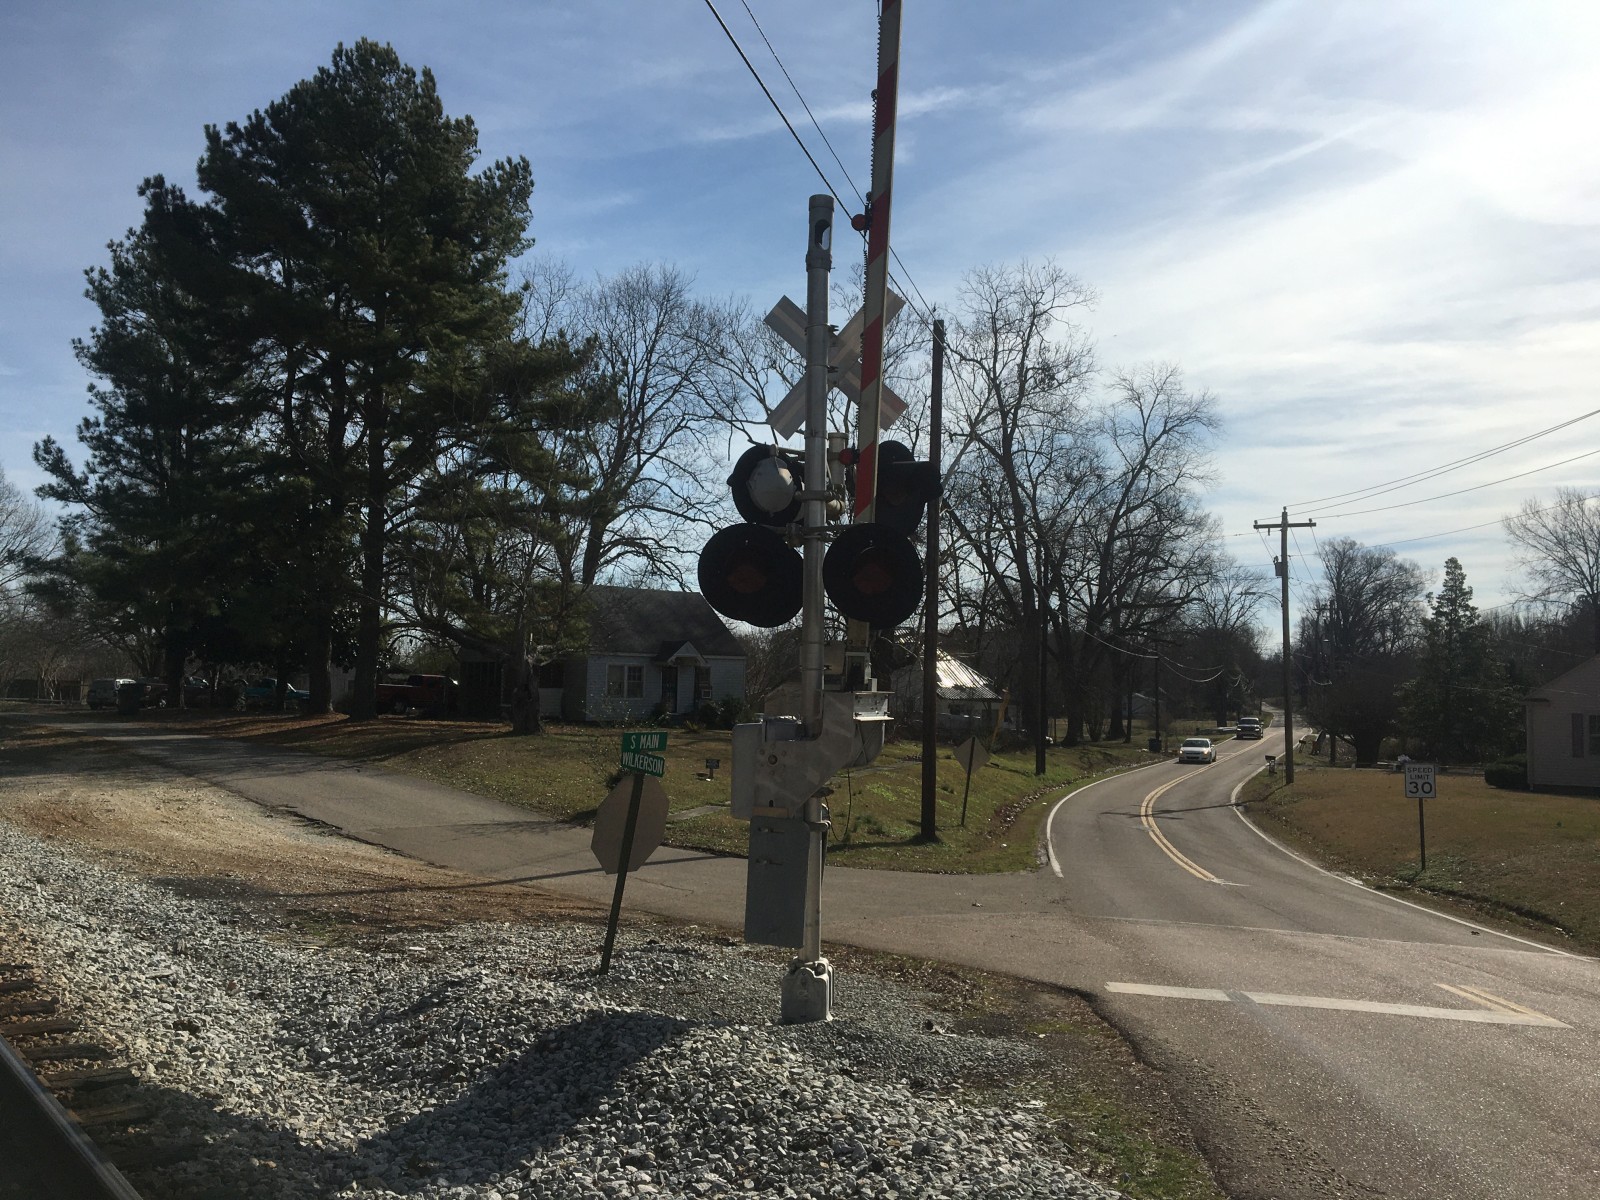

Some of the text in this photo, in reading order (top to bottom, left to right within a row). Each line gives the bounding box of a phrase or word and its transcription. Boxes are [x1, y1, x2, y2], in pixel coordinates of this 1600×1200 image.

[630, 734, 660, 749] S MAIN
[622, 752, 663, 775] WILKERSON
[1408, 781, 1433, 794] 30
